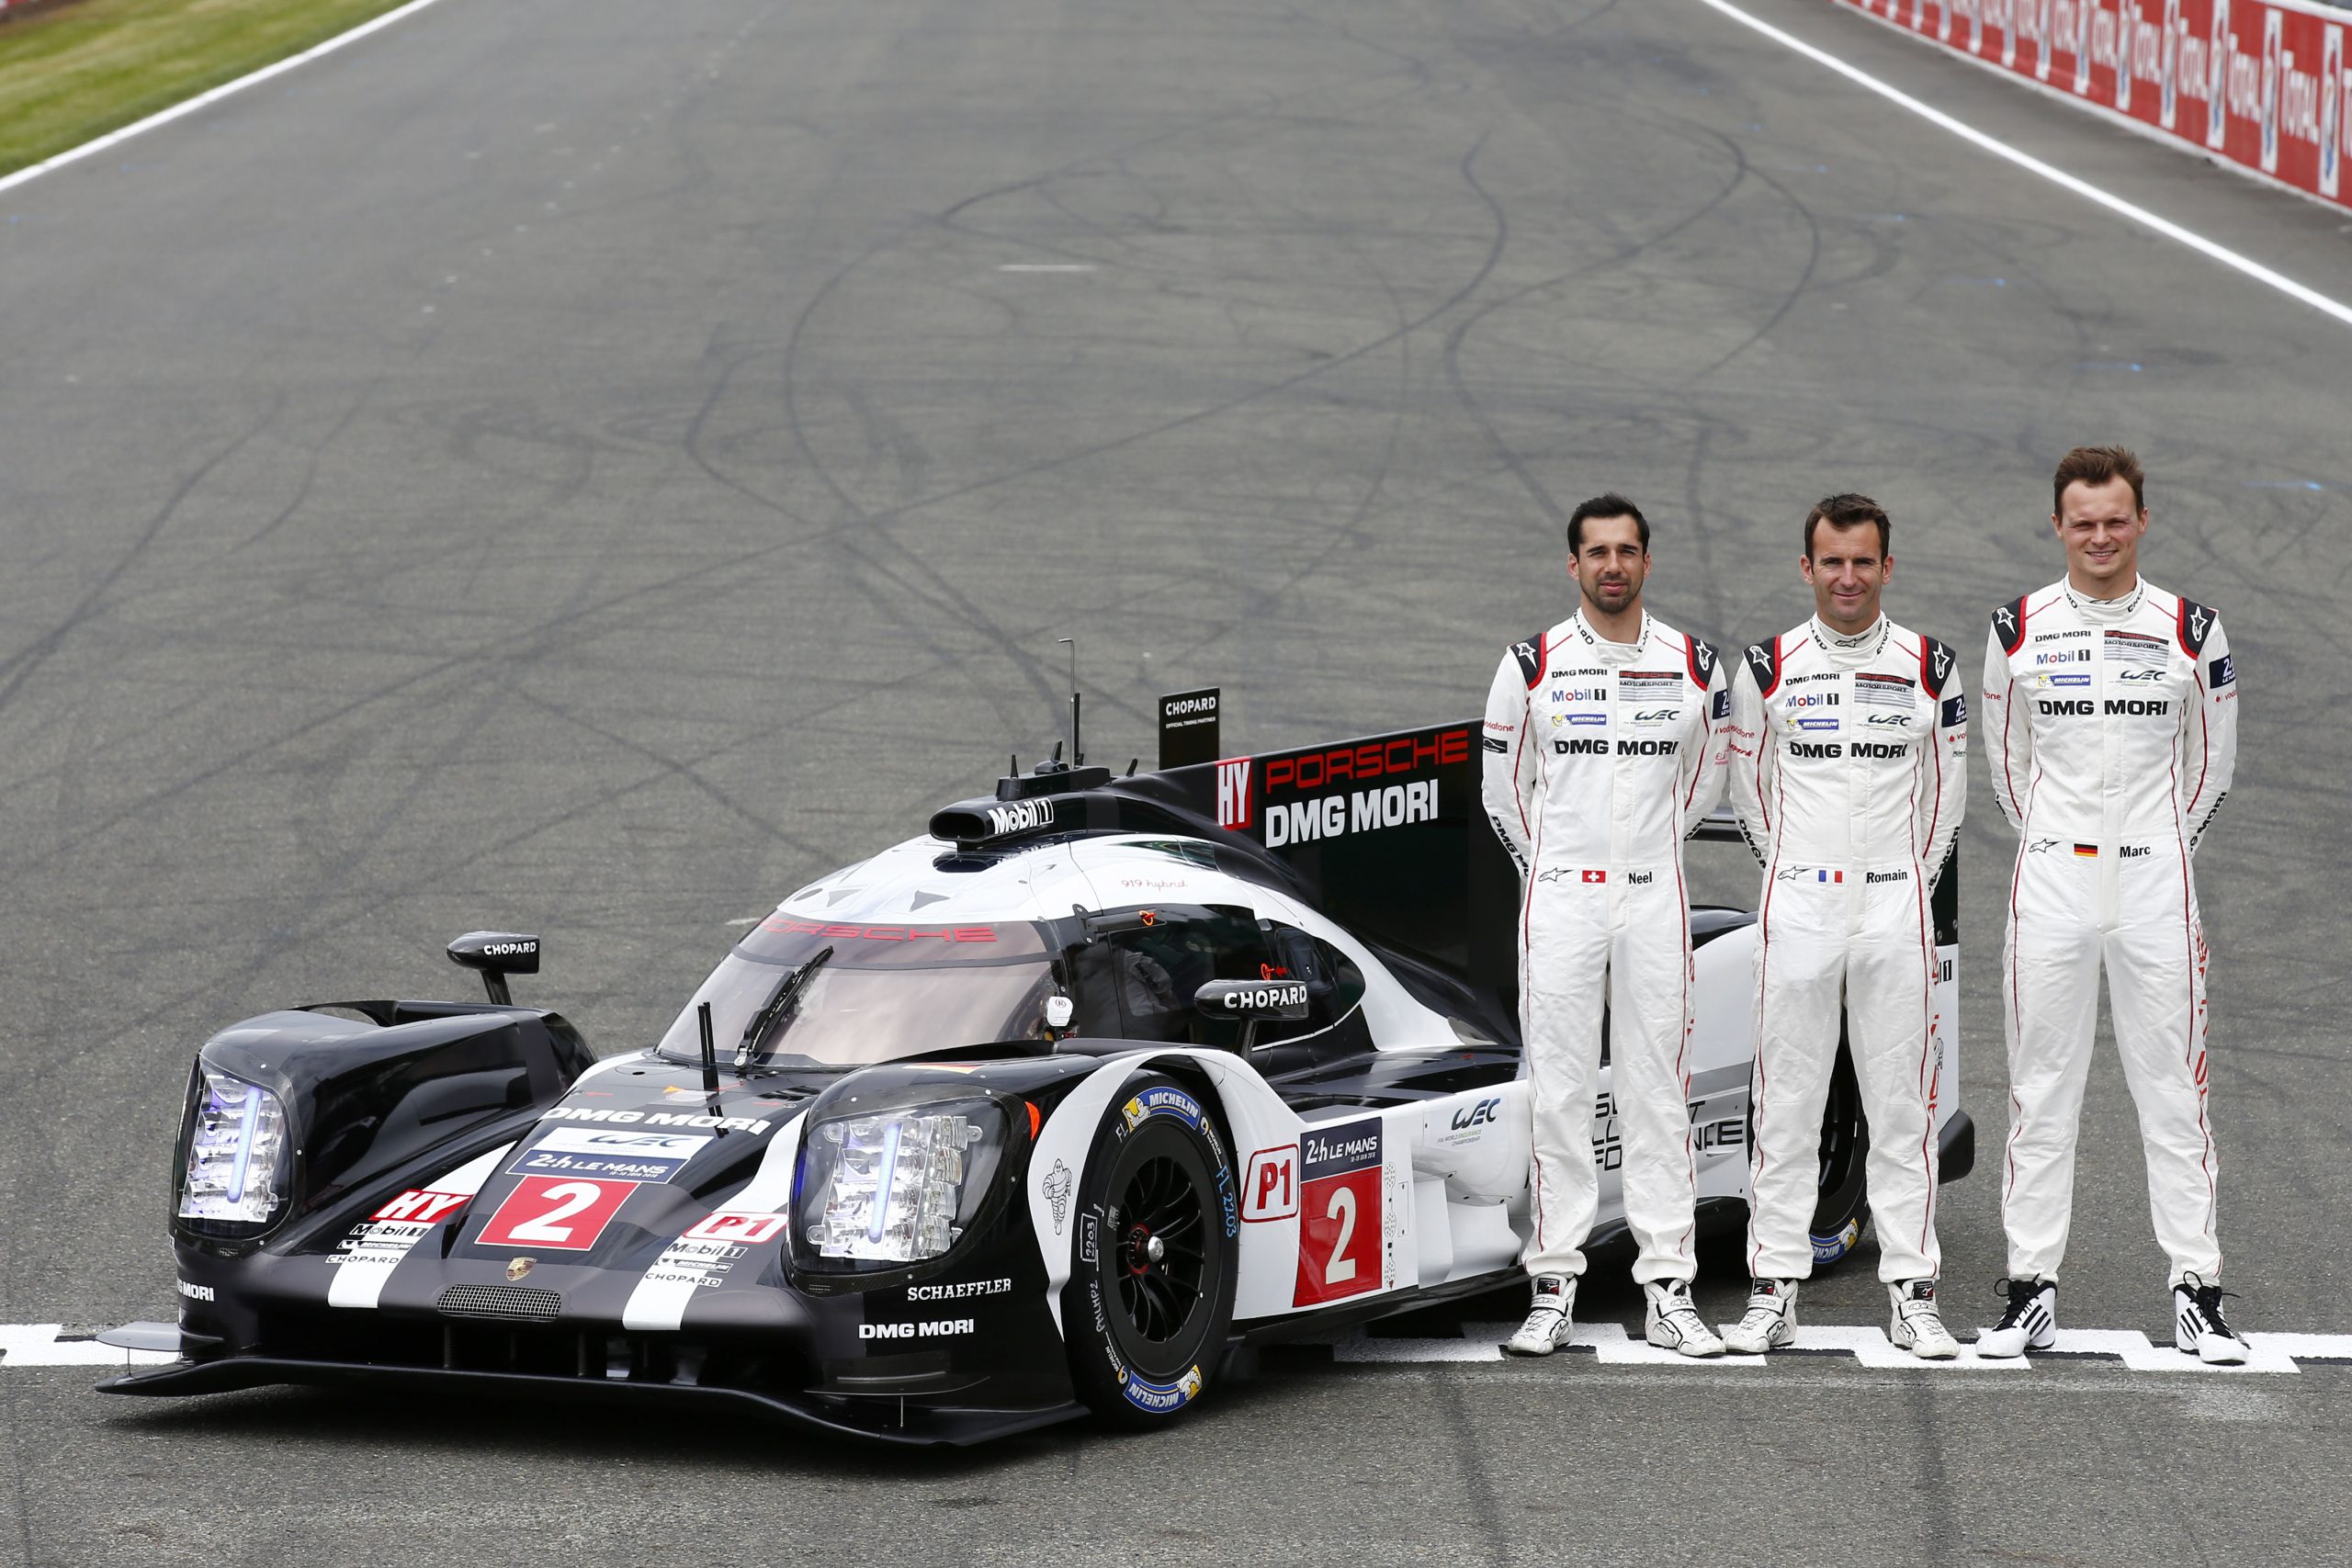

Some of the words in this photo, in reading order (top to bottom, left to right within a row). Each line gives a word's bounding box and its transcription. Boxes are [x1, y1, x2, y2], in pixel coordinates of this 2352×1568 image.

[2282, 50, 2319, 145] TOTAL
[2035, 633, 2060, 642] DMG
[2062, 630, 2091, 639] MORI
[2104, 639, 2159, 650] MOTORSPORT
[2037, 650, 2075, 665] Mobil
[1552, 670, 1577, 679] DMG
[1578, 669, 1608, 677] MORI
[1785, 677, 1809, 686] DMG
[1811, 673, 1840, 682] MORI
[2054, 677, 2090, 685] MICHELIN
[2120, 670, 2166, 681] WEC
[1855, 682, 1906, 693] MOTORSPORT
[1552, 689, 1591, 703] Mobil
[1785, 694, 1823, 708] Mobil
[1165, 696, 1217, 716] CHOPARD
[2039, 700, 2094, 716] DMG
[2104, 700, 2168, 716] MORI
[1571, 716, 1606, 725] MICHELIN
[1634, 709, 1680, 720] WEC
[1868, 714, 1912, 727] WEC
[1803, 720, 1838, 729] MICHELIN
[1555, 739, 1609, 755] DMG
[1617, 740, 1679, 756] MORI
[1790, 741, 1842, 759] DMG
[1850, 742, 1907, 760] MORI
[1266, 729, 1469, 795] PORSCHE
[1217, 761, 1250, 826] HY
[987, 799, 1038, 834] Mobil
[1265, 795, 1346, 849] DMG
[1351, 779, 1439, 833] MORI
[2197, 792, 2227, 834] MORI
[1492, 816, 1517, 853] DMG
[1739, 818, 1762, 859] DMG
[2120, 846, 2151, 859] Marc
[1121, 879, 1143, 888] 919
[1628, 871, 1653, 885] Neel
[1866, 869, 1907, 884] Romain
[483, 942, 537, 955] CHOPARD
[1224, 985, 1307, 1010] CHOPARD
[1148, 1091, 1199, 1119] MICHELIN
[539, 1107, 645, 1123] DMG
[644, 1111, 772, 1136] MORI
[1451, 1097, 1502, 1131] WEC
[588, 1134, 694, 1148] WEC
[1305, 1135, 1329, 1165] 24h
[1329, 1143, 1344, 1159] LE
[1344, 1135, 1378, 1155] MANS
[526, 1153, 574, 1168] 24h
[571, 1160, 605, 1171] LE
[601, 1162, 670, 1176] MANS
[1256, 1158, 1291, 1211] P1
[375, 1193, 470, 1221] HY
[507, 1181, 603, 1243] 2
[352, 1225, 410, 1236] Mobil
[704, 1215, 776, 1237] P1
[1325, 1186, 1357, 1285] 2
[361, 1242, 412, 1250] MICHELIN
[666, 1243, 724, 1257] Mobil
[327, 1256, 400, 1265] CHOPARD
[675, 1259, 731, 1271] MICHELIN
[645, 1272, 720, 1286] CHOPARD
[183, 1280, 215, 1302] MORI
[907, 1278, 1012, 1302] SCHAEFFLER
[858, 1323, 915, 1339] DMG
[918, 1318, 975, 1338] MORI
[1128, 1382, 1180, 1409] MICHELIN
